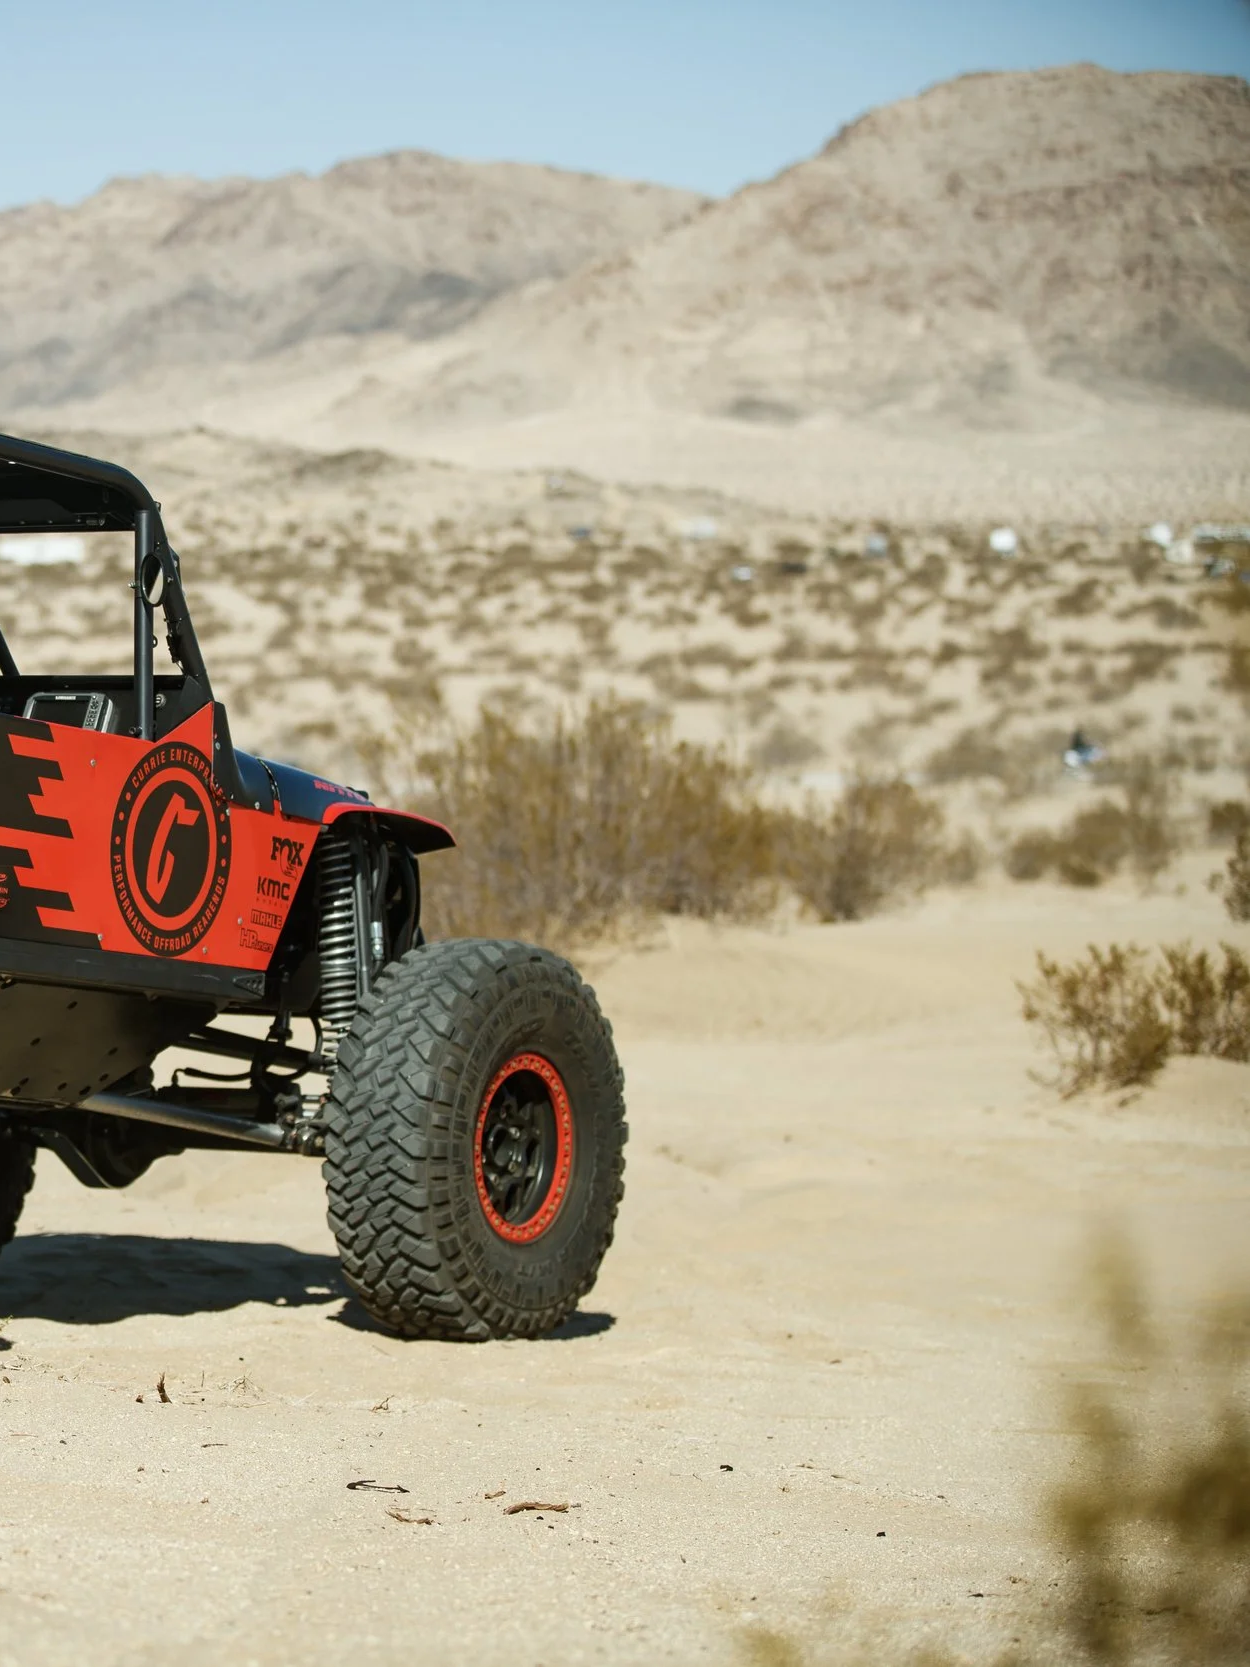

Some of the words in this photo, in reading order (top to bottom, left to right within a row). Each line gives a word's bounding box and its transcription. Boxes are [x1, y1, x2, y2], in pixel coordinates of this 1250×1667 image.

[131, 750, 166, 789] CURRIE
[271, 836, 304, 867] FOX
[113, 854, 152, 944] PERFORMANCE
[153, 932, 192, 951] OFFROAD
[193, 876, 226, 939] REARENDS
[257, 876, 290, 901] KMC
[251, 909, 282, 930] MAHLE
